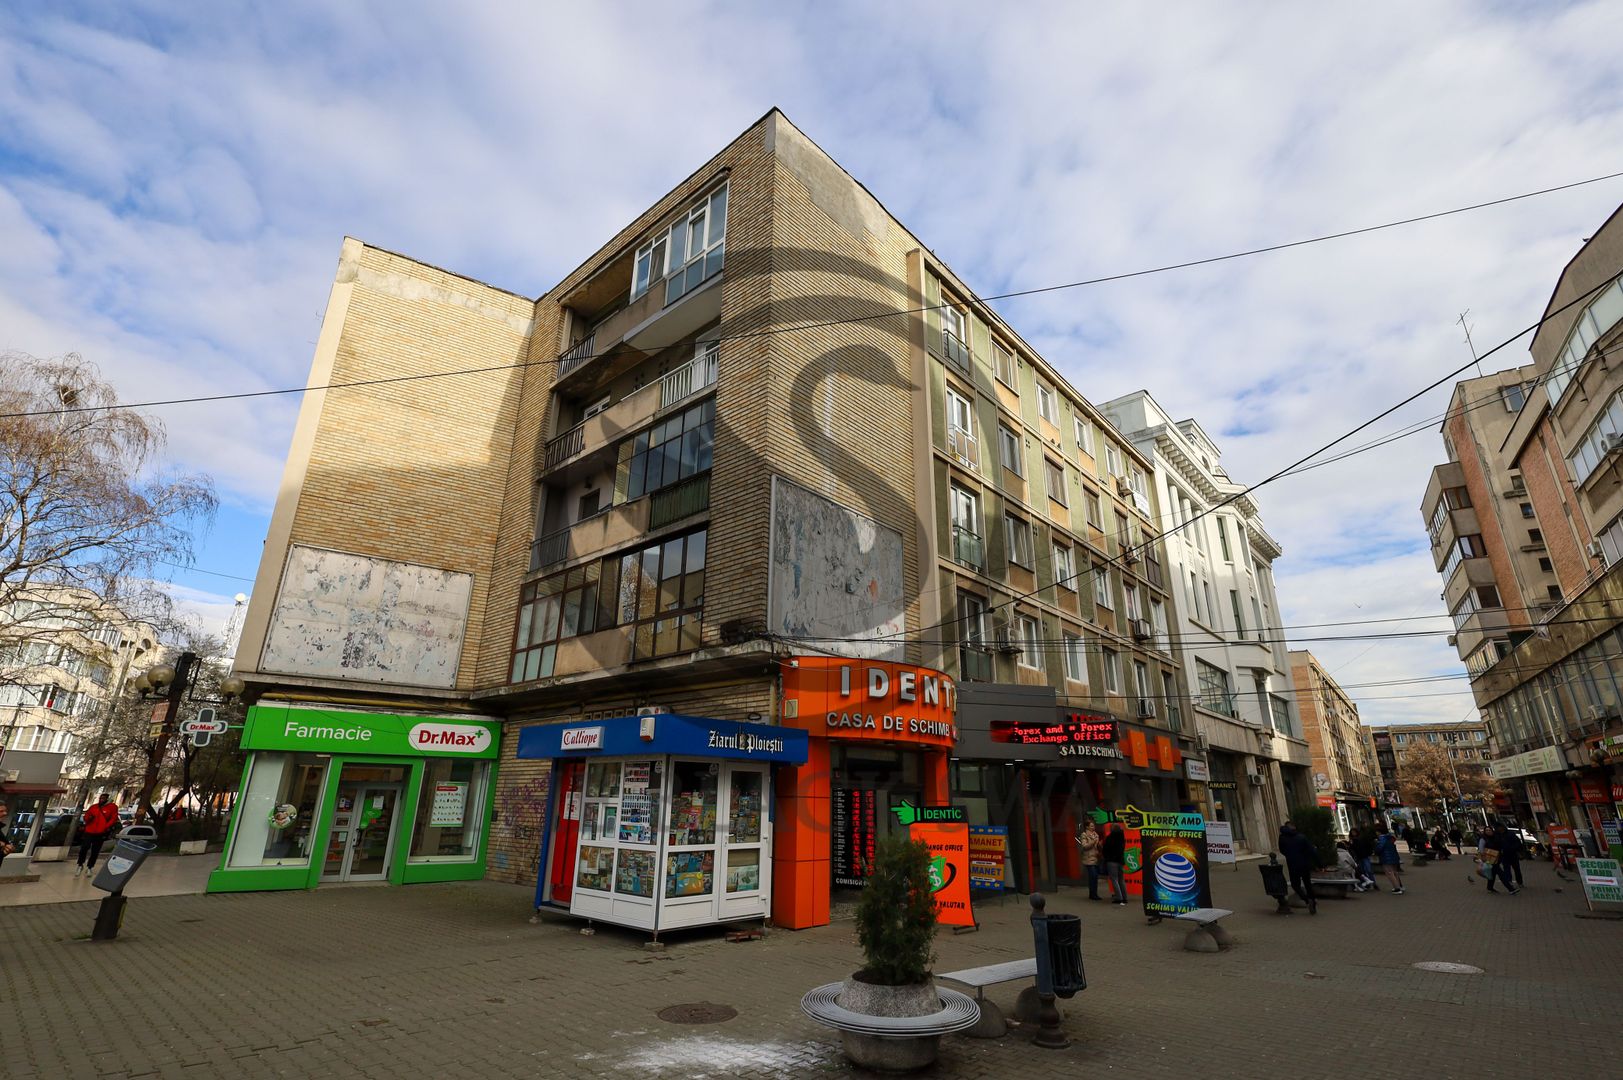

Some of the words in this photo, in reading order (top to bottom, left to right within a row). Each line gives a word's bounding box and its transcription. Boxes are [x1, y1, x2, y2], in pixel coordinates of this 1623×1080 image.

[827, 711, 876, 729] CASA
[883, 715, 904, 731] DE
[910, 718, 950, 736] SCHIMB
[1080, 723, 1112, 732] Forex
[284, 721, 372, 741] Farmacie
[418, 729, 476, 746] Dr.Max
[562, 729, 598, 746] Calliope
[708, 729, 738, 749] Ziarul
[1022, 735, 1068, 744] Exchange
[1074, 731, 1111, 741] Office
[1059, 744, 1076, 756] SA
[1077, 745, 1091, 756] DE
[1152, 816, 1179, 827] FOREX
[1181, 816, 1202, 826] AMD
[1141, 829, 1177, 838] EXCHANGE
[1178, 830, 1203, 839] OFFICE
[944, 844, 964, 852] OFFICE
[1580, 860, 1617, 870] SECOND
[972, 866, 1002, 876] MANET
[939, 901, 965, 910] VALUTAR
[1146, 902, 1175, 912] SCHIMB
